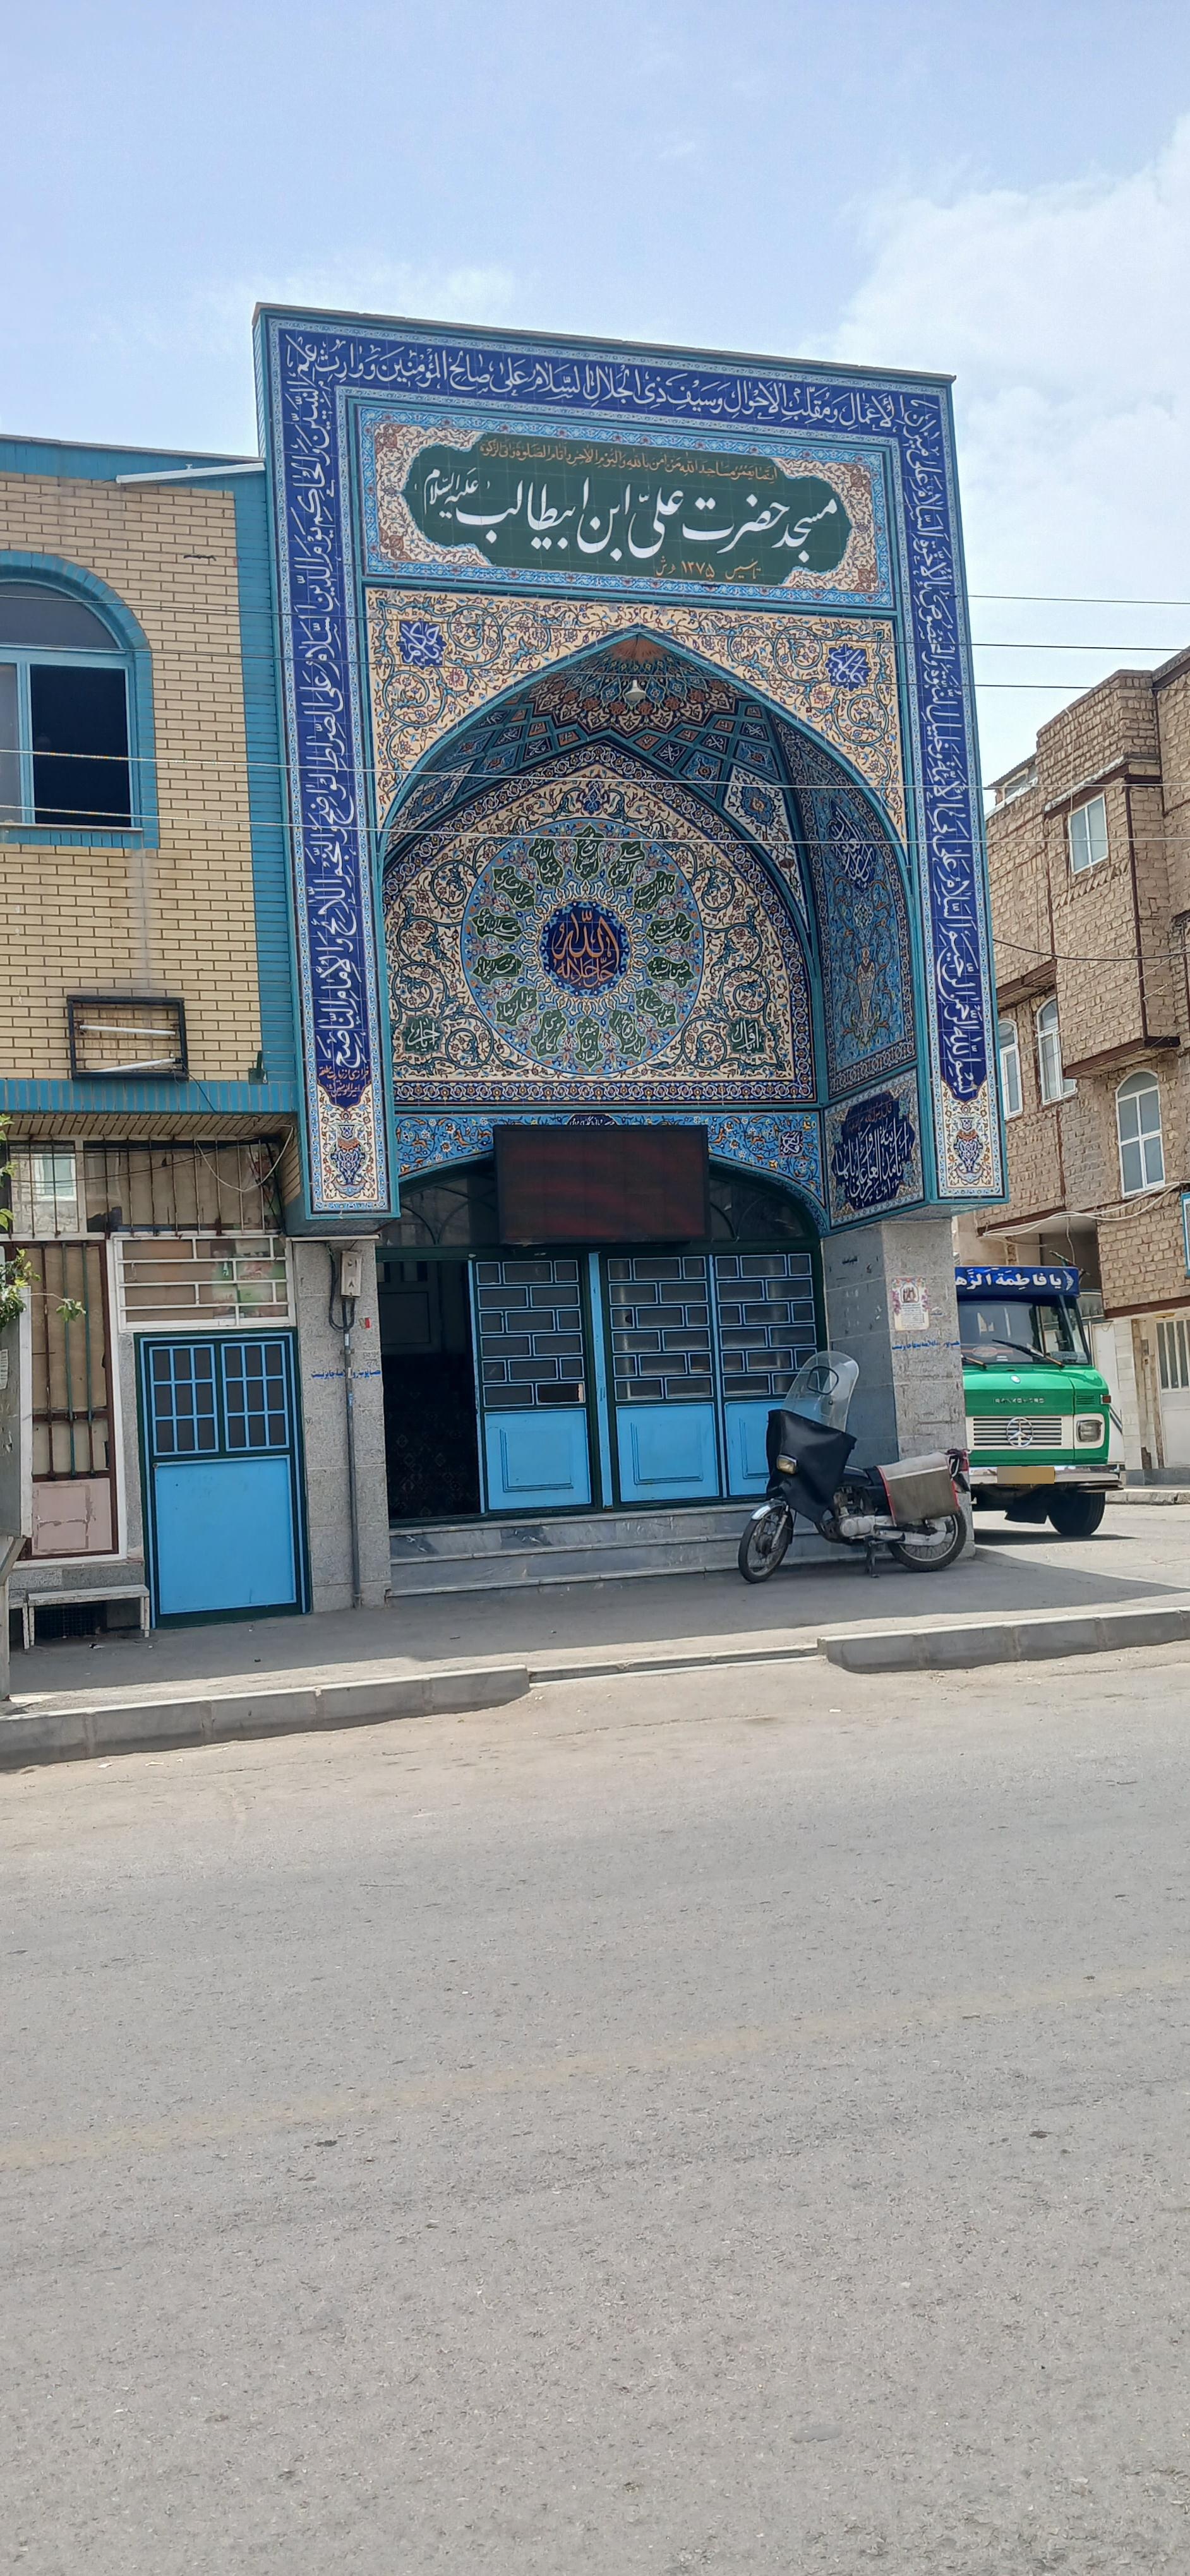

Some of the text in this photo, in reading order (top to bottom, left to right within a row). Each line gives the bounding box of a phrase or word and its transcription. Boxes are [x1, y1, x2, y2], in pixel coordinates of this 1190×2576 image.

[577, 484, 630, 563] ابن
[628, 487, 684, 559] علی
[682, 494, 788, 554] حضرت
[772, 498, 838, 563] مسجد
[681, 559, 716, 579] ۱۳۷۵
[551, 910, 620, 970] الله
[1049, 1273, 1062, 1289] یا
